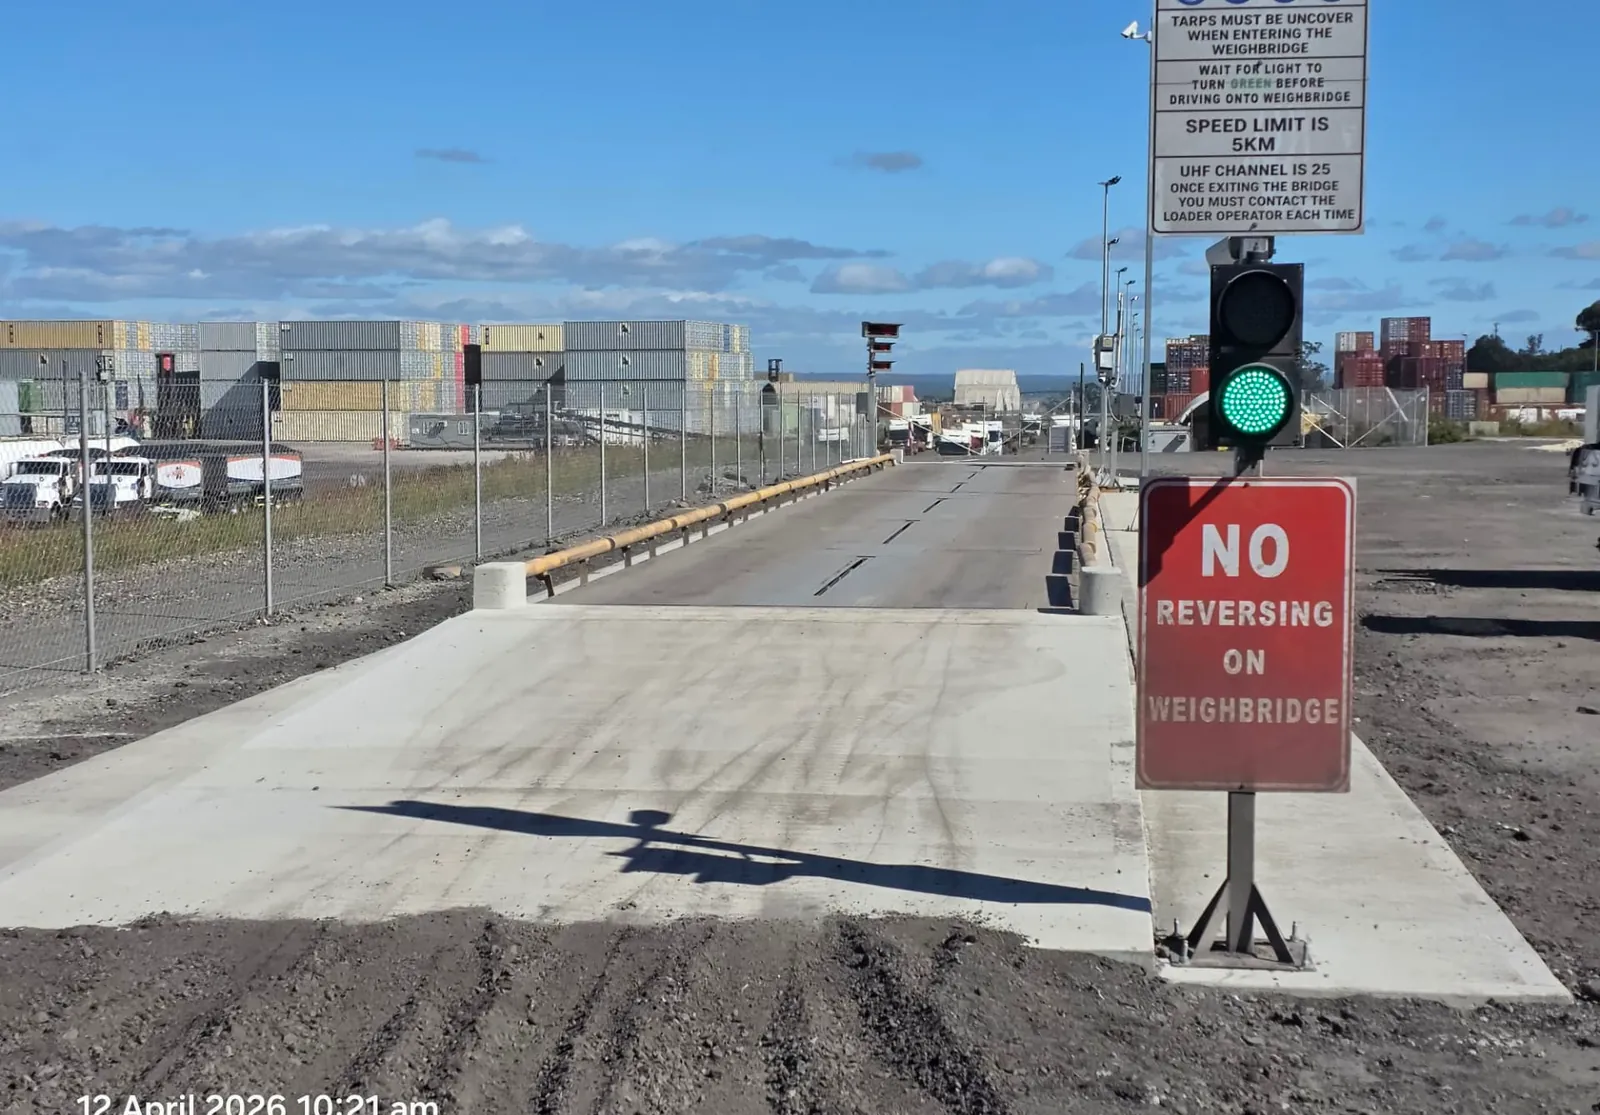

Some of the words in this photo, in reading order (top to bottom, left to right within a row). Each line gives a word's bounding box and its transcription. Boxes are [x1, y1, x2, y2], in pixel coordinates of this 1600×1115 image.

[1172, 15, 1217, 27] TARPS
[1221, 14, 1262, 26] MUST
[1266, 13, 1284, 25] BE
[1287, 12, 1354, 25] UNCOVER
[1188, 29, 1229, 41] WHEN
[1233, 28, 1302, 40] ENTERING
[1306, 27, 1333, 39] THE
[1212, 42, 1309, 56] WEIGHBRIDGE
[1199, 64, 1231, 76] WAIT
[1236, 63, 1260, 75] FOR
[1265, 63, 1301, 74] LIGHT
[1307, 63, 1322, 74] TO
[1192, 80, 1225, 90] TURN
[1230, 78, 1272, 89] GREEN
[1276, 78, 1325, 88] BEFORE
[1169, 93, 1221, 105] DRIVING
[1225, 93, 1258, 104] ONTO
[1263, 91, 1351, 103] WEIGHBRIDGE
[1186, 118, 1247, 134] SPEED
[1253, 117, 1306, 132] LIMIT
[1311, 116, 1329, 131] IS
[1232, 137, 1275, 152] 5KM
[1180, 165, 1210, 177] UHF
[1215, 164, 1288, 177] CHANNEL
[1293, 164, 1307, 176] IS
[1311, 163, 1331, 175] 25
[1170, 183, 1205, 194] ONCE
[1208, 182, 1259, 193] EXITING
[1262, 182, 1288, 192] THE
[1291, 181, 1339, 192] BRIDGE
[1179, 197, 1204, 208] YOU
[1208, 197, 1245, 207] MUST
[1248, 196, 1306, 206] CONTACT
[1310, 195, 1336, 205] THE
[1163, 212, 1213, 222] LOADER
[1217, 211, 1283, 221] OPERATOR
[1286, 210, 1321, 220] EACH
[1324, 209, 1355, 219] TIME
[1201, 523, 1290, 578] NO
[1157, 600, 1333, 627] REVERSING
[1223, 649, 1265, 675] ON
[1148, 697, 1340, 724] WEIGHBRIDGE
